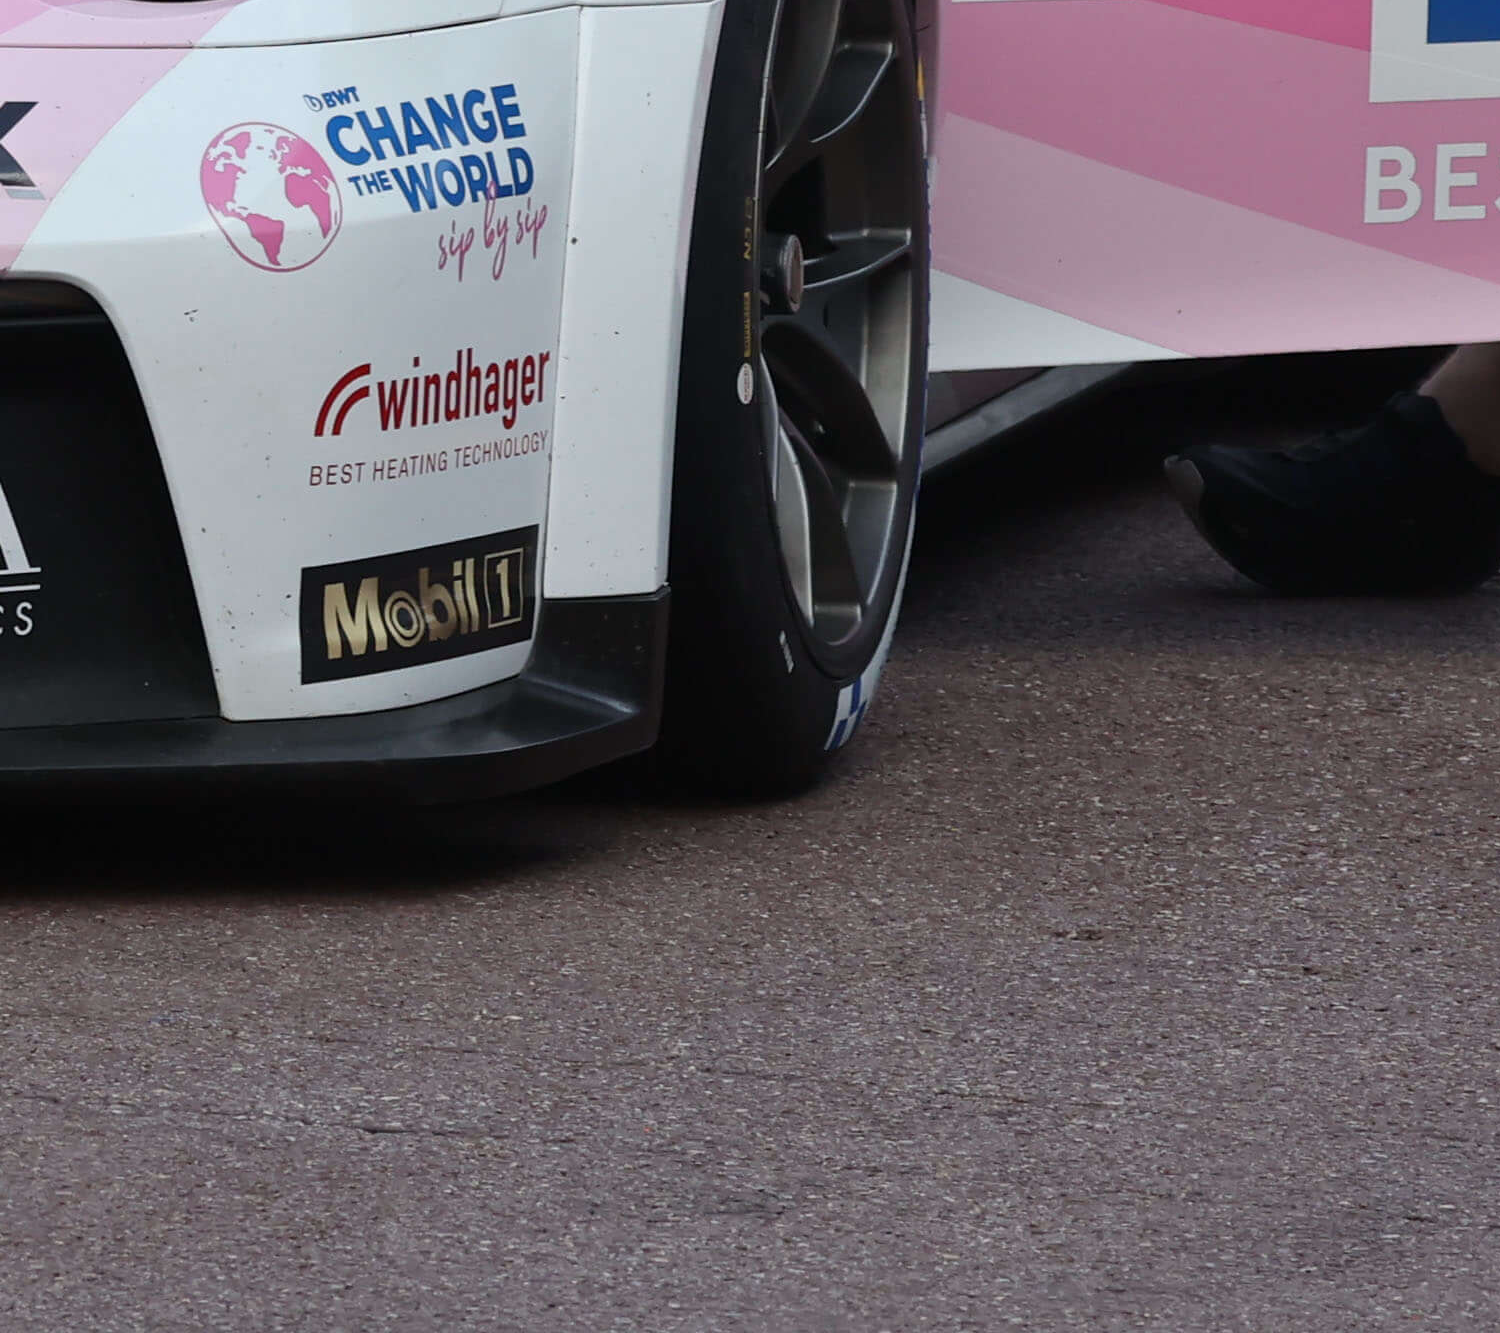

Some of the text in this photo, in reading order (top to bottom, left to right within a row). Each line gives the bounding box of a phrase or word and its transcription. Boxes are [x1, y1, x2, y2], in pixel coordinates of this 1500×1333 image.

[321, 85, 361, 109] BWT
[326, 83, 527, 166] CHANGE
[349, 146, 536, 213] THE WORLD
[438, 180, 549, 283] sip by sip
[377, 347, 551, 432] windhager
[309, 429, 550, 486] BEST HEATING TECHNOLOGY
[324, 558, 482, 660] Mobil
